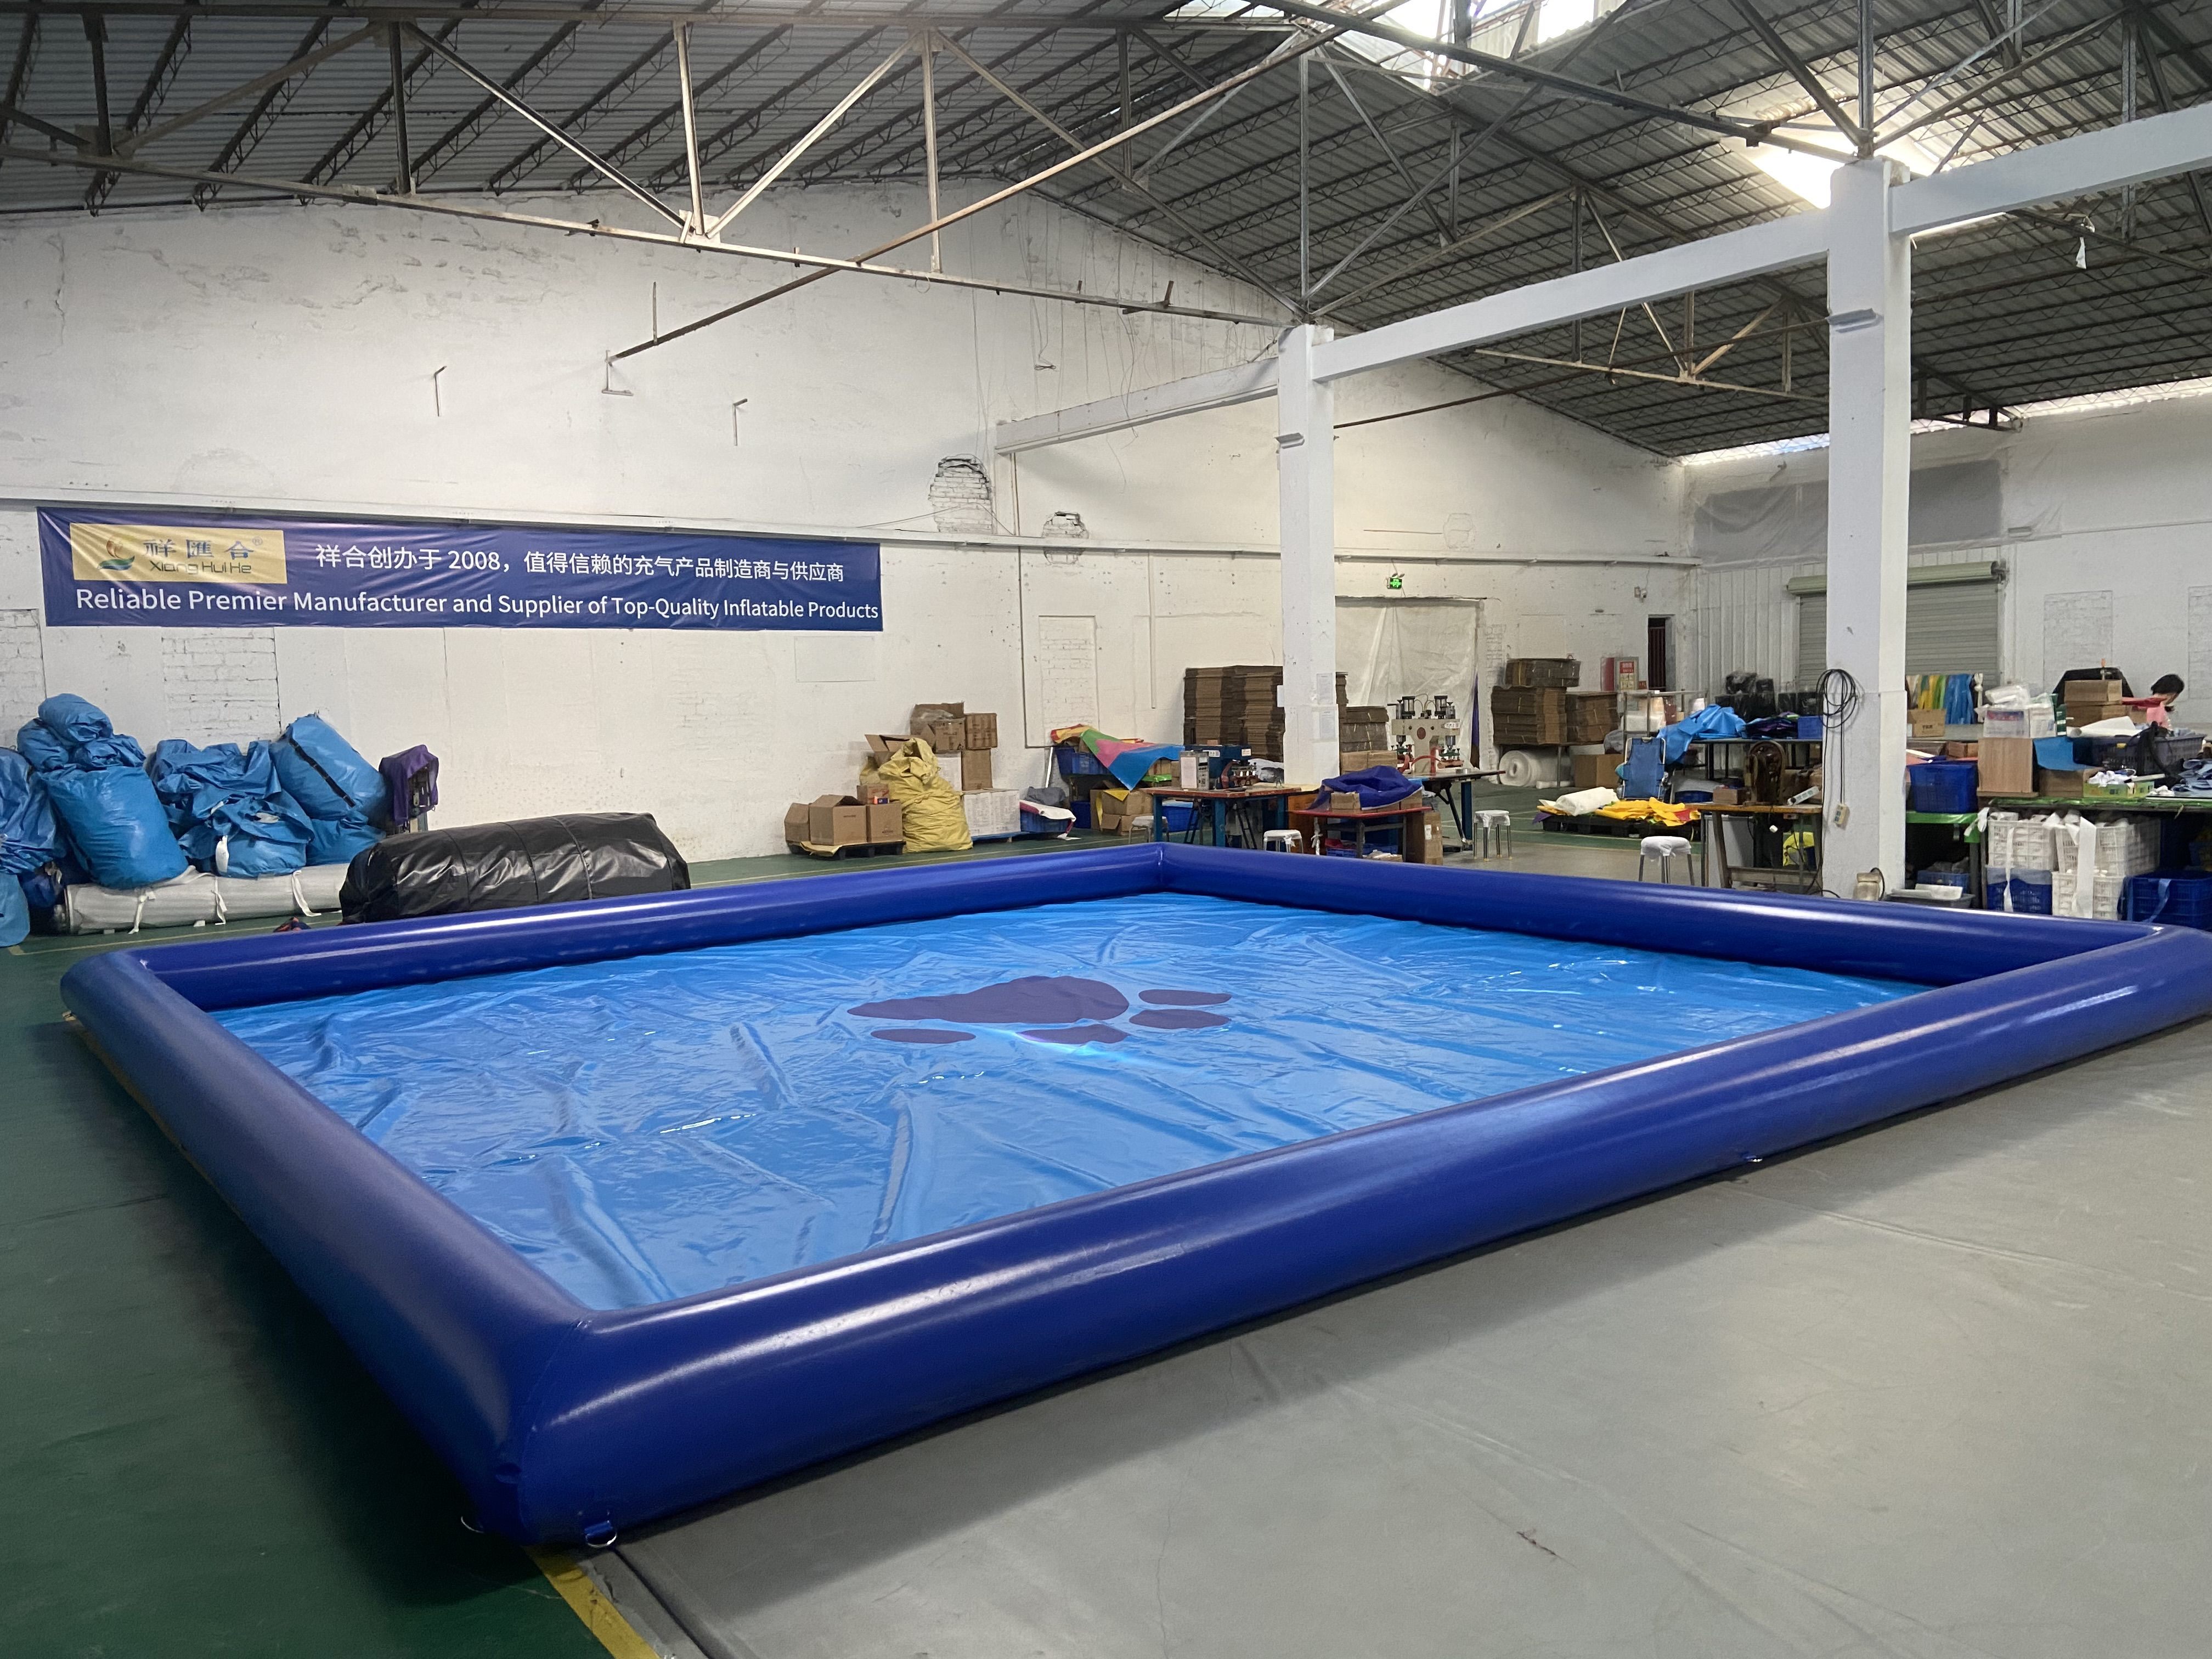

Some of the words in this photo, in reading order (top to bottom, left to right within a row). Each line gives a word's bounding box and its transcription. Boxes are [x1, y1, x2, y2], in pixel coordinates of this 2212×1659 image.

[315, 544, 443, 571] 祥合创办于
[523, 551, 844, 583] 值得信赖的充气产品制造商与供应商
[76, 588, 181, 610] Reliable
[189, 590, 287, 611] Premier
[294, 592, 447, 612] Manufacturer
[453, 594, 493, 613] and
[498, 595, 584, 618] Supplier
[588, 596, 608, 614] of
[611, 597, 719, 620] Top-Quality
[724, 599, 804, 618] Inflatable
[808, 601, 879, 619] Products
